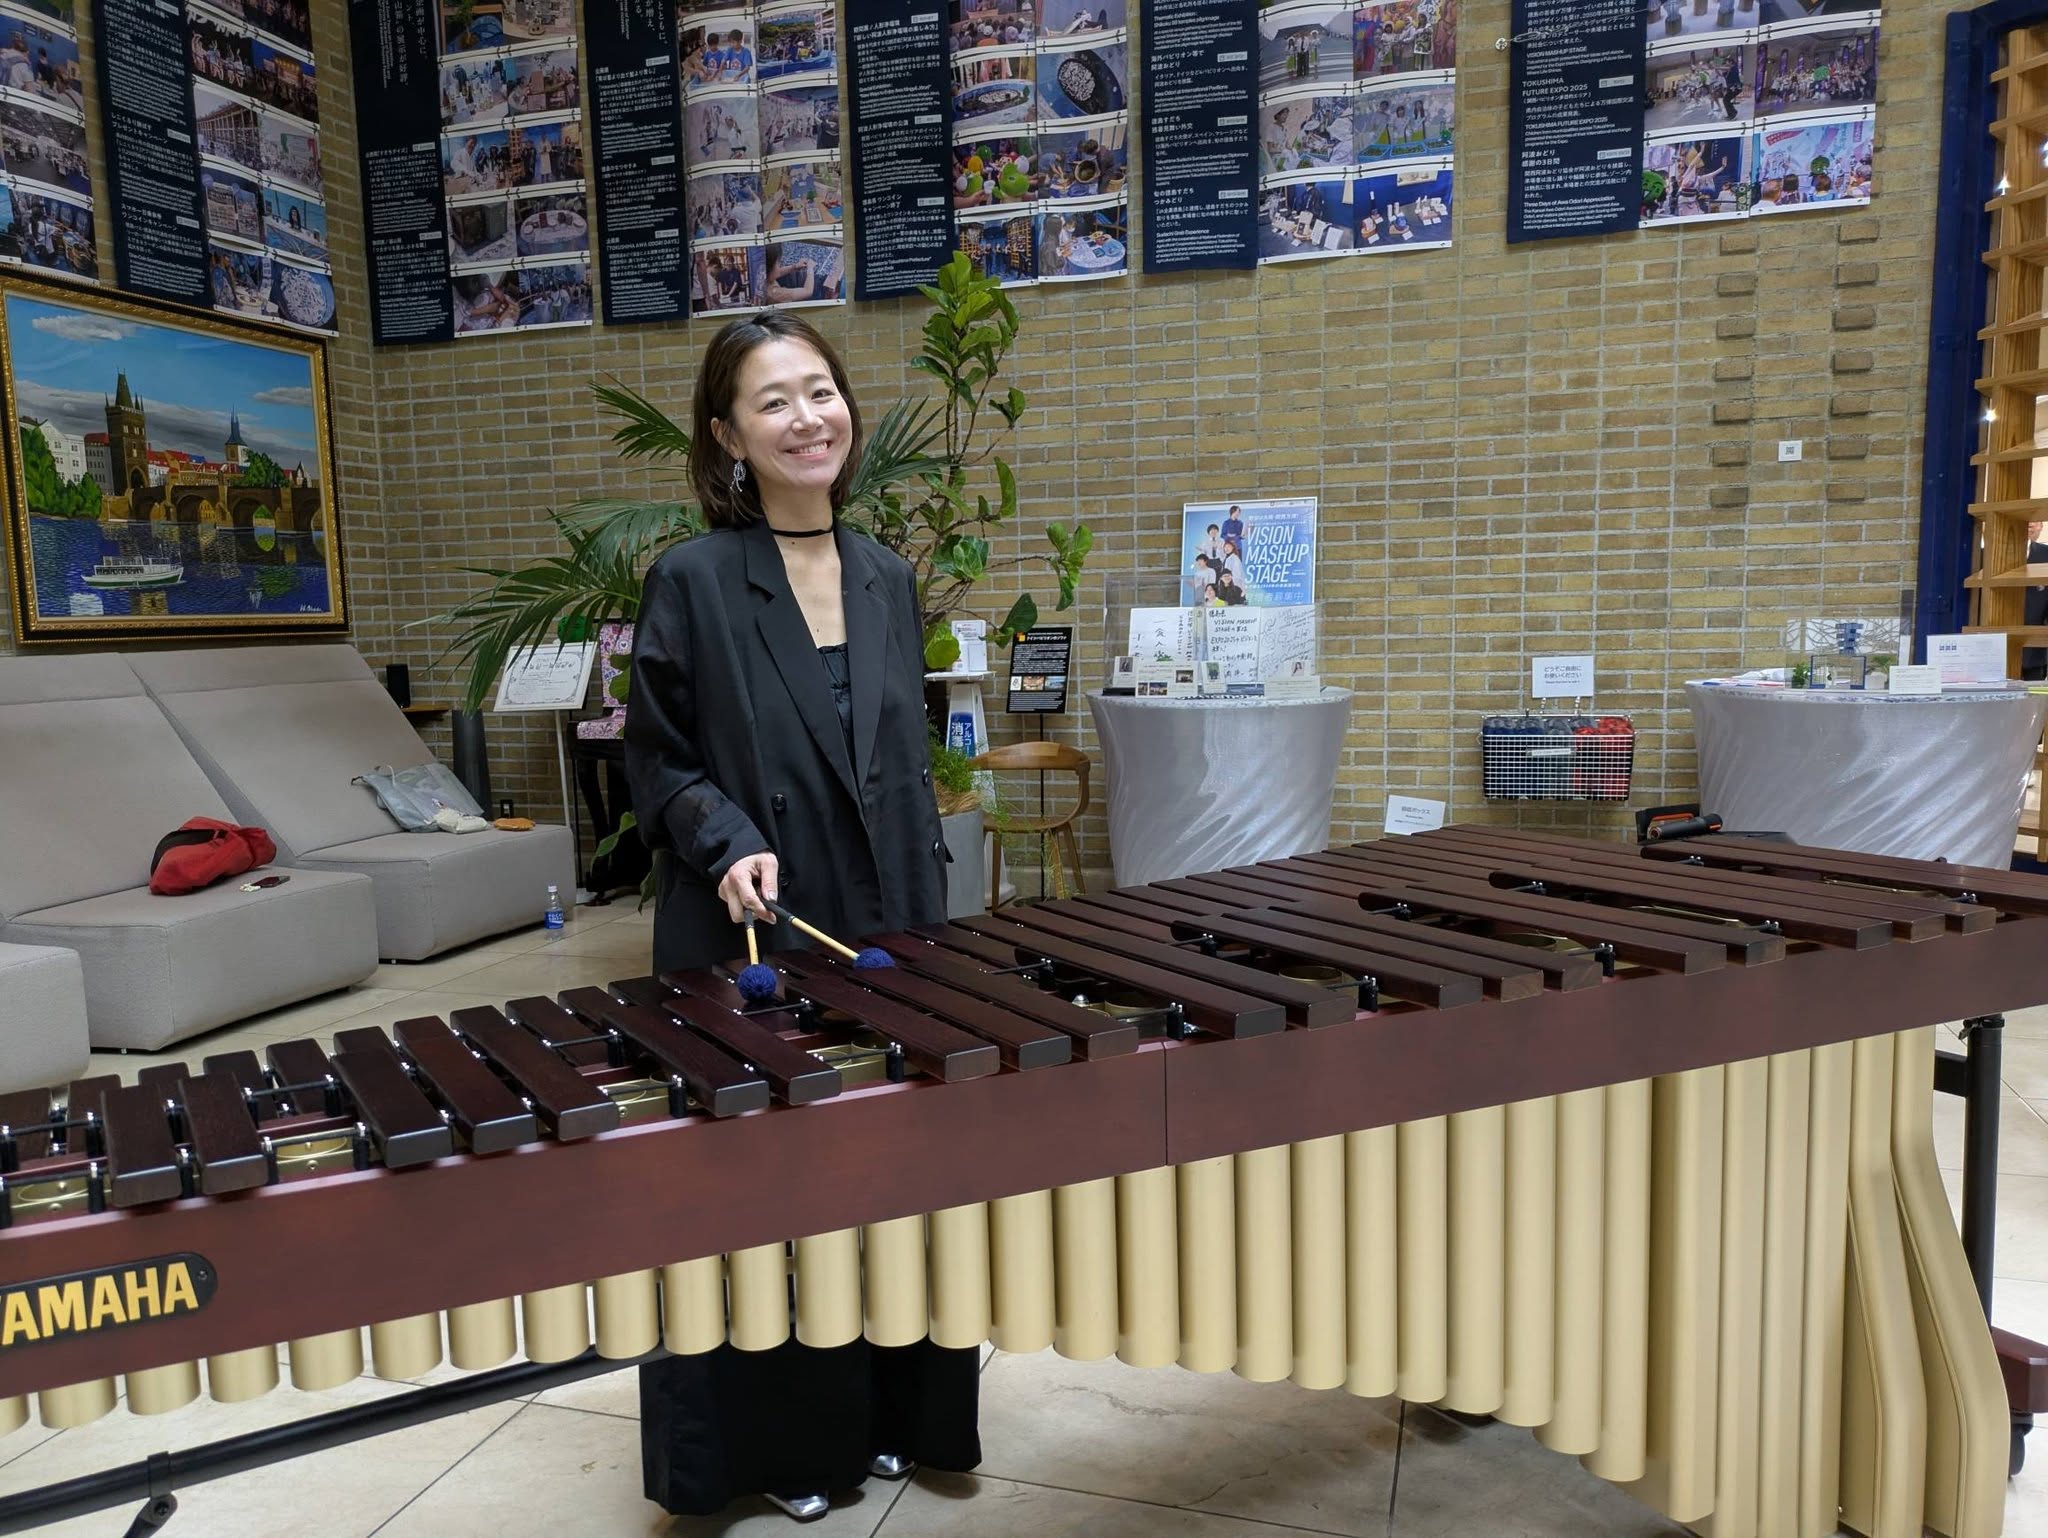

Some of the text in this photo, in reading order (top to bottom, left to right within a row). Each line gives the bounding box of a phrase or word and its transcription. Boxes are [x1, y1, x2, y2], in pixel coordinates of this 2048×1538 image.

[1522, 78, 1564, 87] TOKUSHIMA
[1522, 88, 1548, 96] FUTURE
[1522, 149, 1555, 158] 阿波おどり
[1522, 158, 1560, 167] 感謝の3日間
[1154, 197, 1183, 205] つかみどり
[1247, 525, 1295, 546] VISION
[1245, 544, 1309, 565] MASHUP
[1245, 563, 1292, 584] STAGE
[952, 722, 964, 751] 消毒
[0, 1261, 198, 1346] AMAHA
